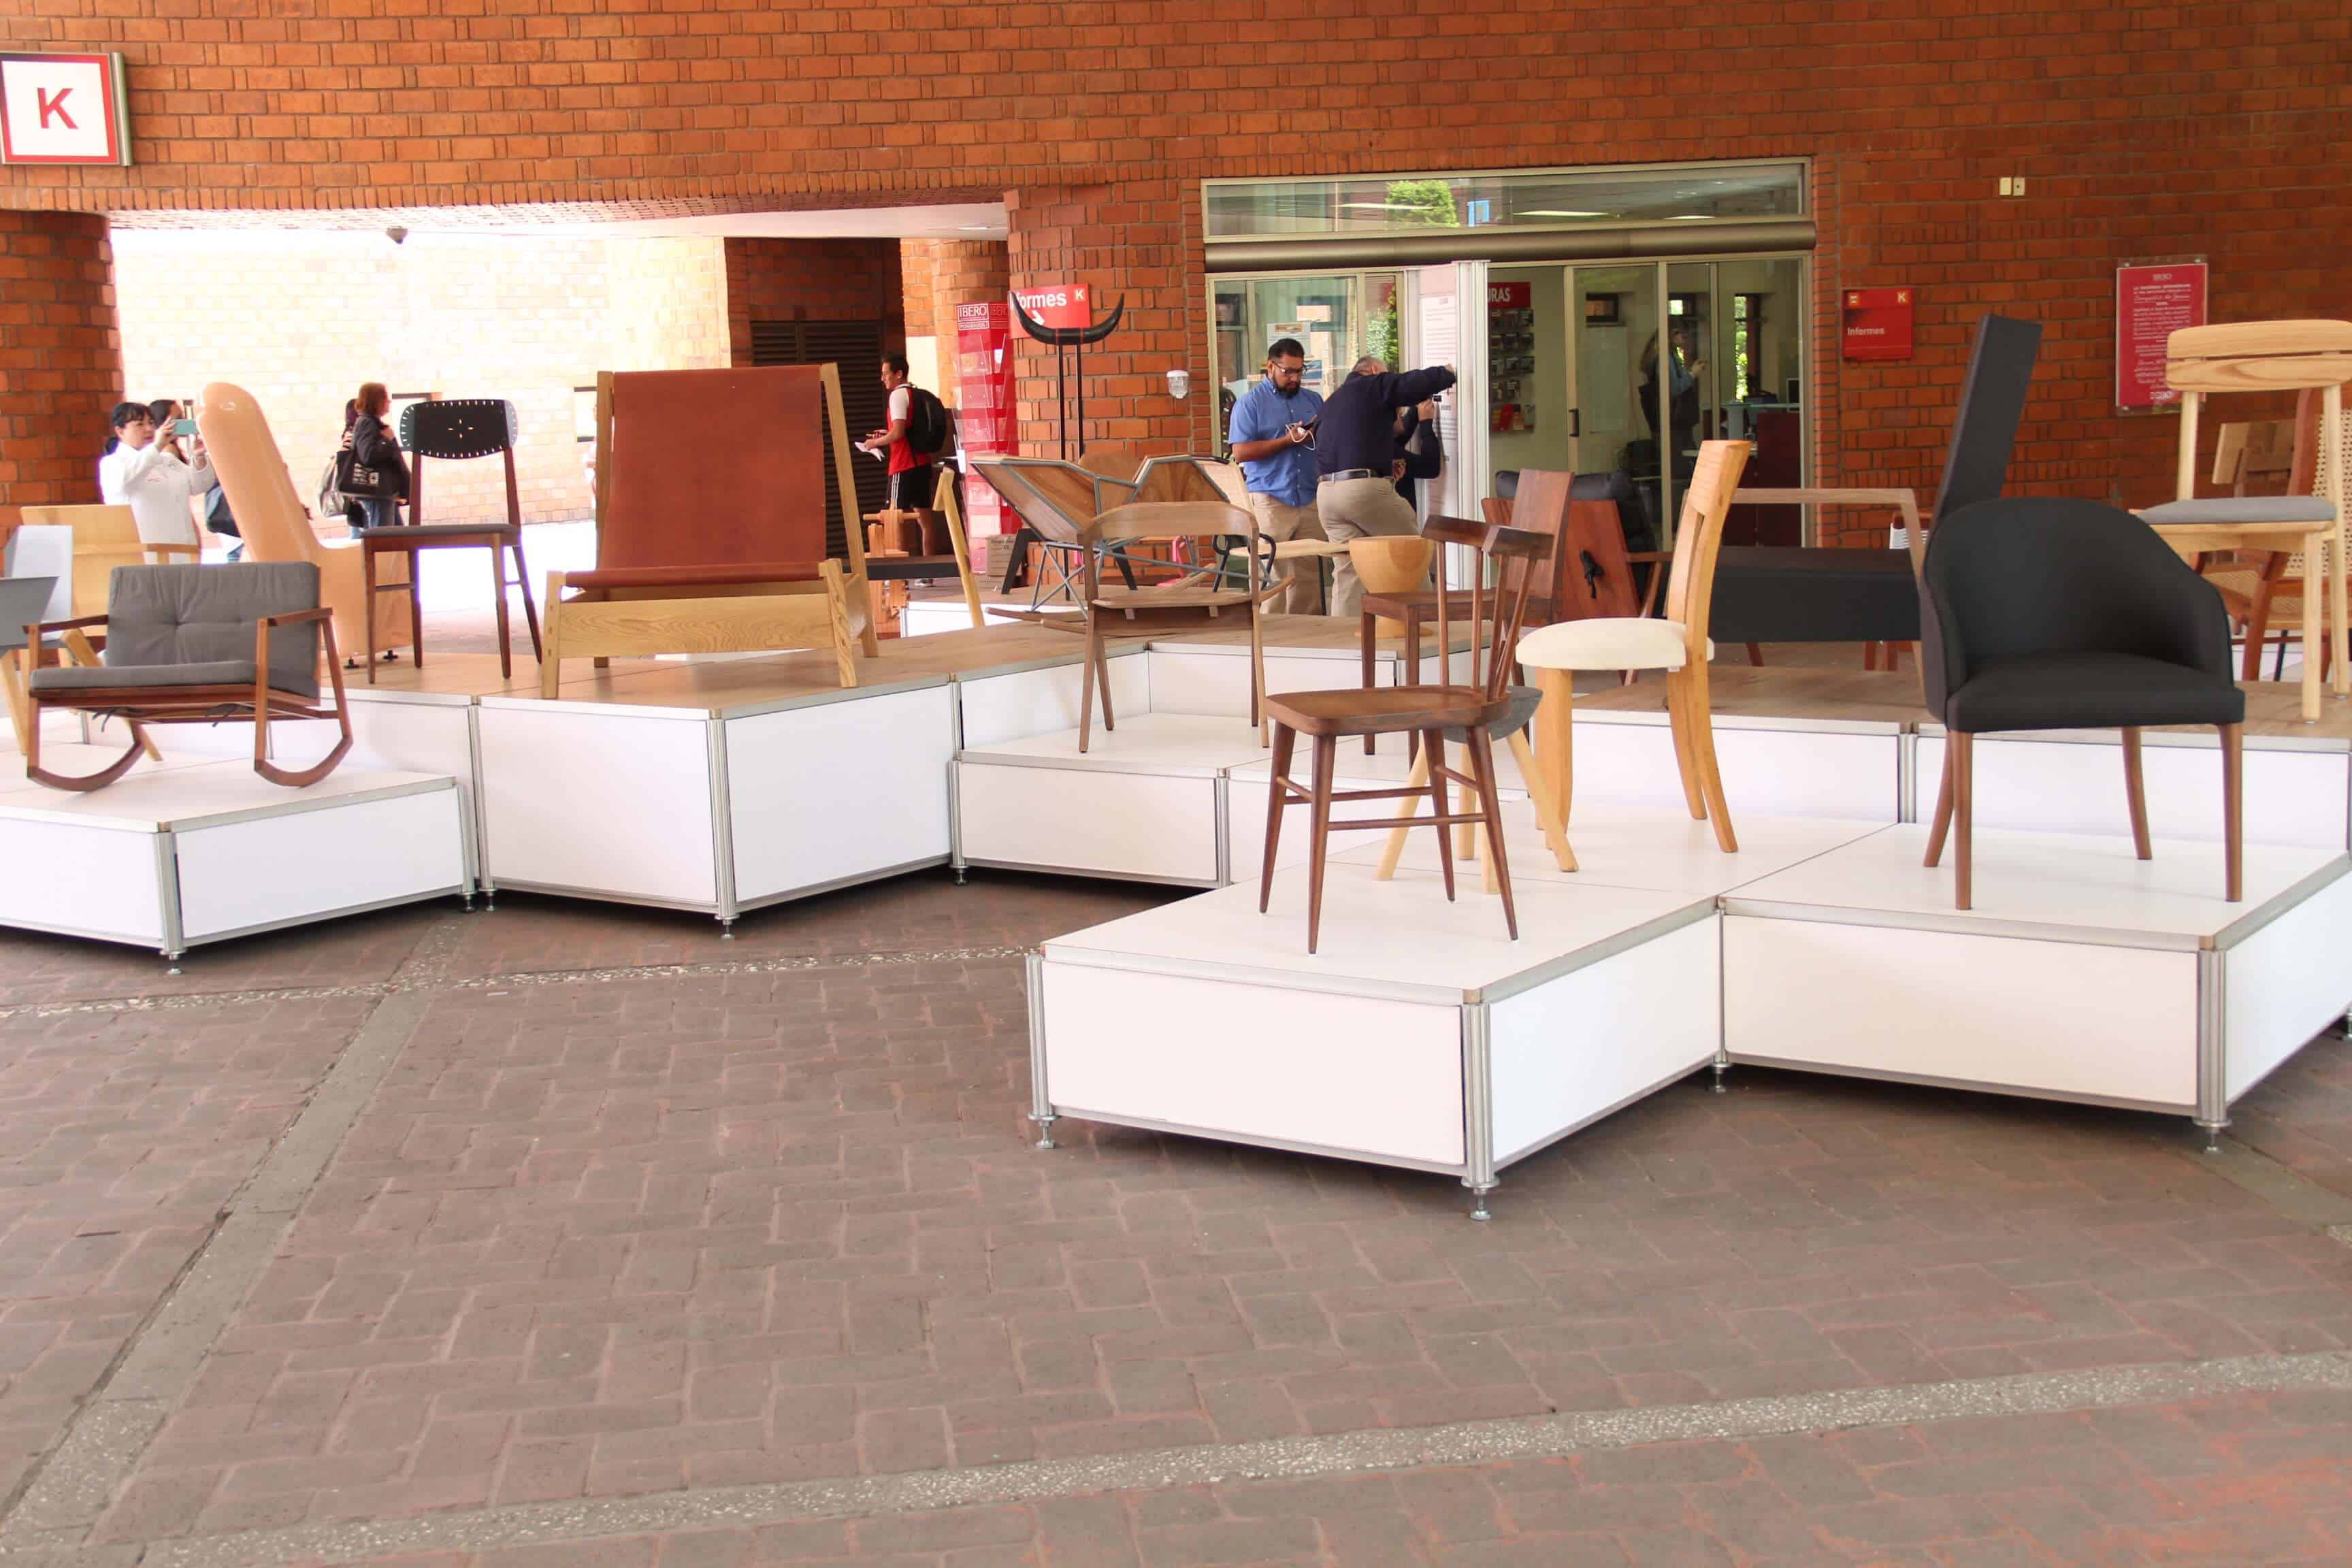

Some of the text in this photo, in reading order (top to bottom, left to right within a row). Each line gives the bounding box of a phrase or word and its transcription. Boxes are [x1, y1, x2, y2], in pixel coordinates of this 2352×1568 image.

[37, 87, 79, 129] K
[1075, 289, 1084, 300] K
[1897, 293, 1906, 304] K
[959, 306, 987, 316] IBERO
